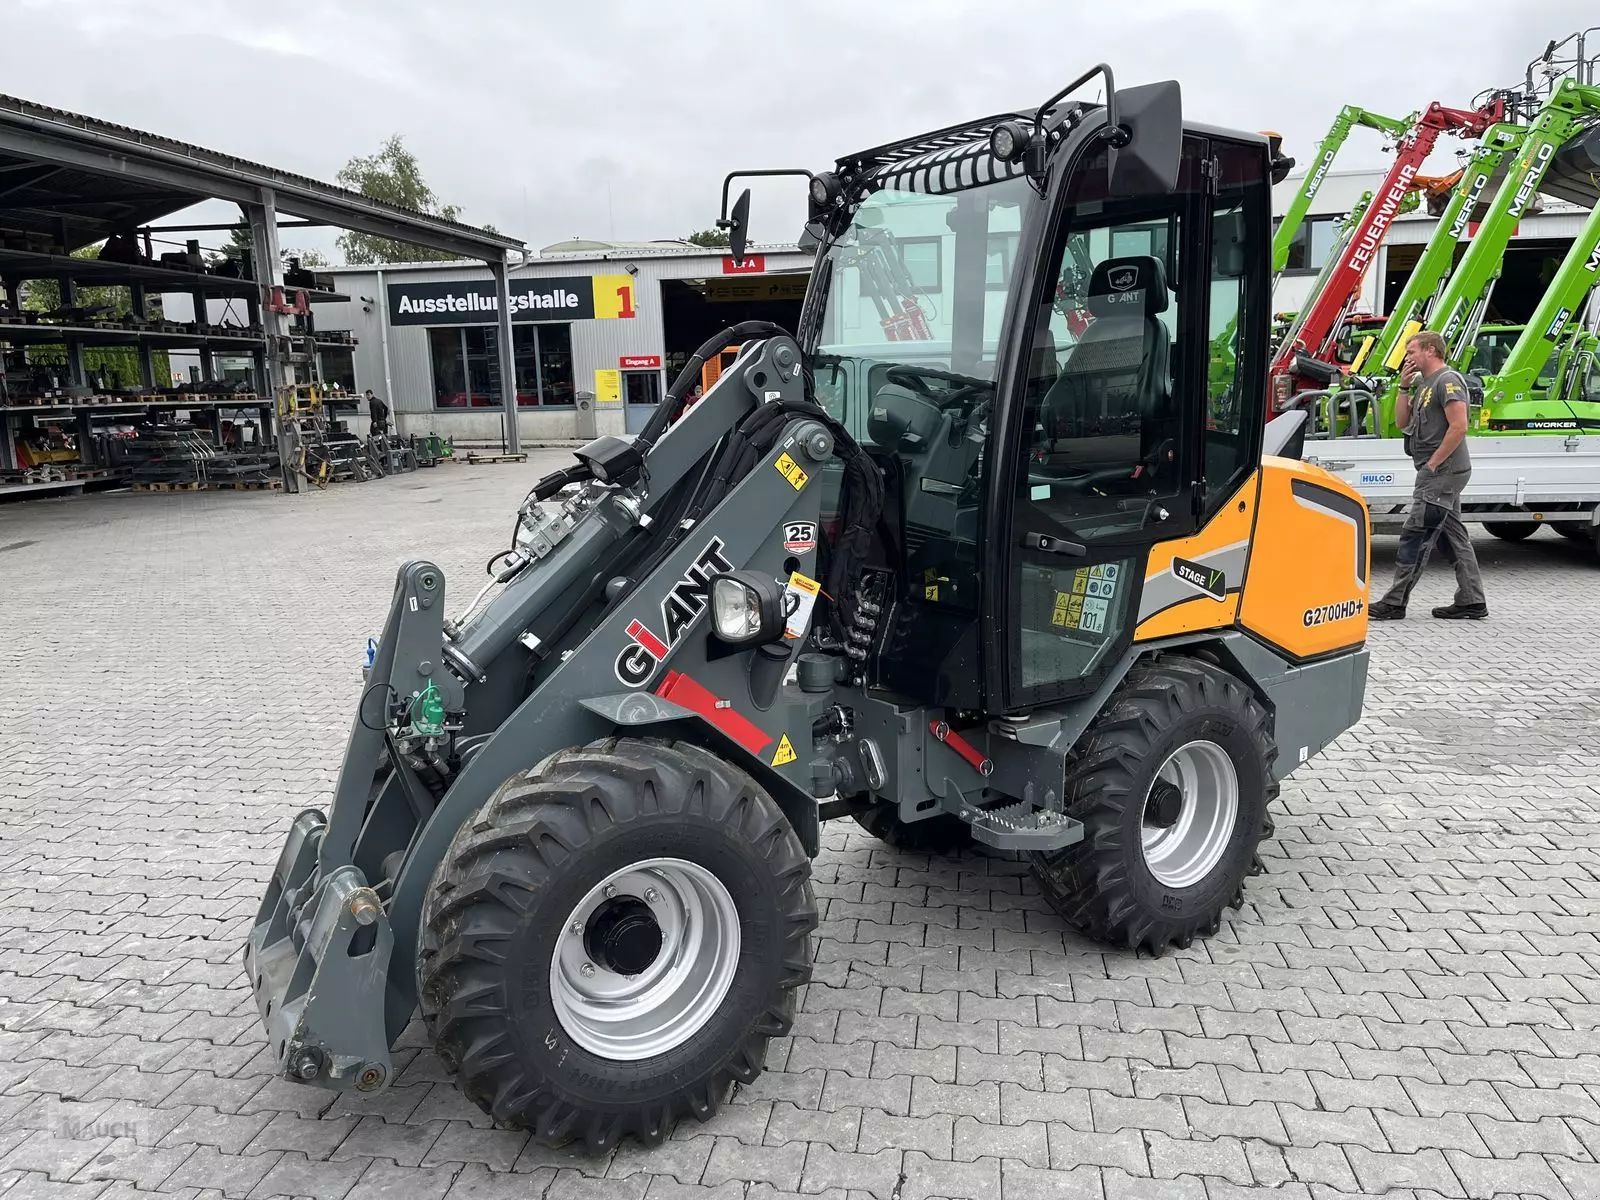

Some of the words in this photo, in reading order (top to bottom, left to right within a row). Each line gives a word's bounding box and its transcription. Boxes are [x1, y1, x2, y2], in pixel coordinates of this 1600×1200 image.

[1305, 150, 1334, 198] MERLO
[1507, 143, 1553, 217] MERLO
[1348, 164, 1418, 272] FEUERWEHR
[1448, 174, 1488, 238] MERLO
[748, 259, 756, 268] A
[616, 286, 636, 318] 1
[789, 526, 811, 542] 25
[1178, 565, 1207, 586] STAGE
[1082, 611, 1098, 630] 101
[1303, 598, 1364, 627] G2700HD+
